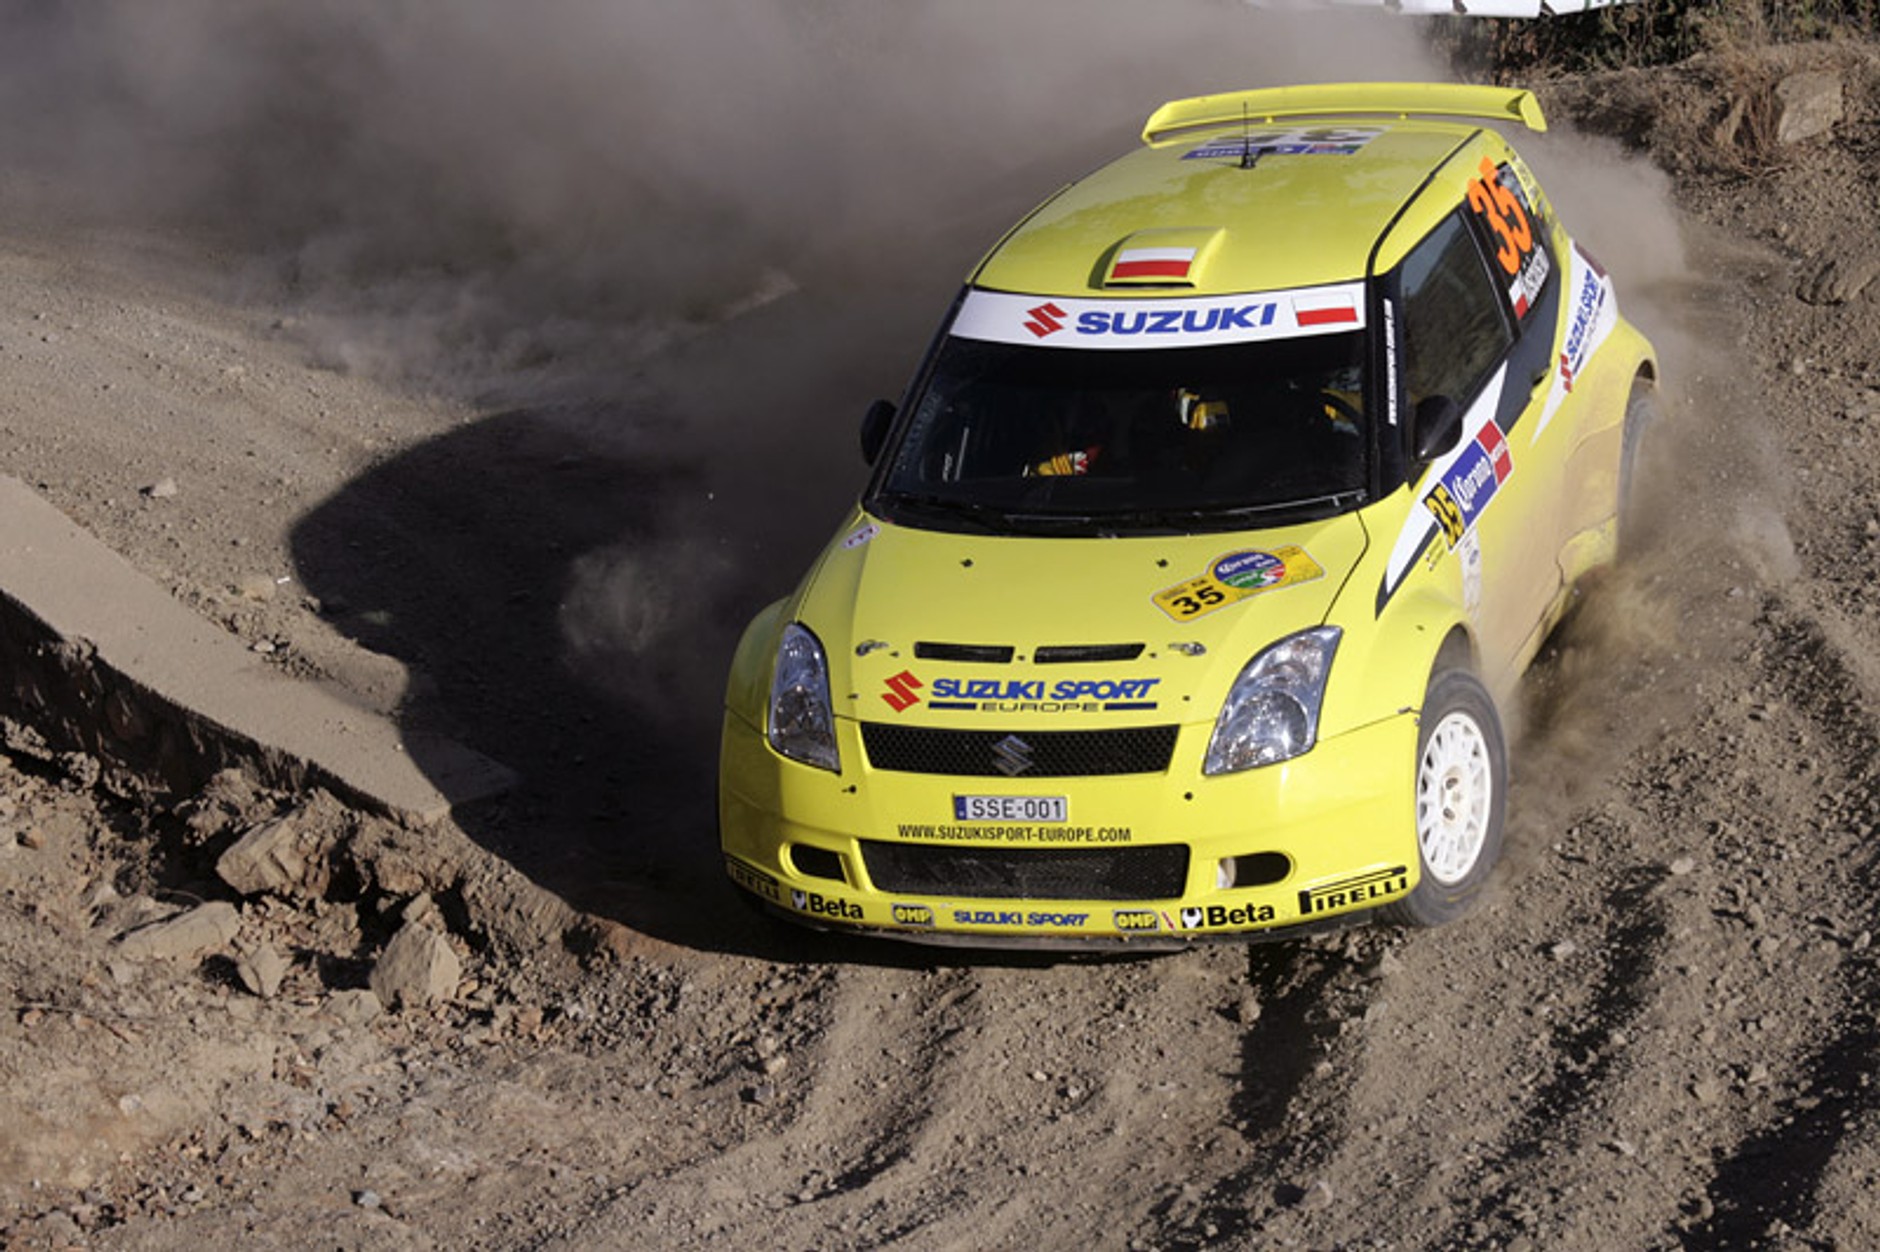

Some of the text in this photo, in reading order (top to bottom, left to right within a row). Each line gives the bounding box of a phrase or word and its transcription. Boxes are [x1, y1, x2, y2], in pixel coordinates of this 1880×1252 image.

[1468, 156, 1533, 275] 35
[1076, 303, 1277, 335] SUZUKI
[1425, 486, 1465, 549] 35
[1172, 585, 1225, 614] 35
[931, 677, 1161, 701] SUZUKI SPORT
[981, 702, 1099, 713] EUROPE
[972, 799, 1062, 819] SSE-001
[898, 825, 1132, 842] WWW.SUZUKISPORT-EUROPE.COM
[1298, 865, 1408, 915] PIRELLI
[809, 893, 864, 920] Beta
[895, 906, 932, 923] OMP
[953, 910, 1089, 927] SUZUKI SPORT
[1207, 903, 1275, 927] Beta
[1116, 913, 1157, 929] OMP
